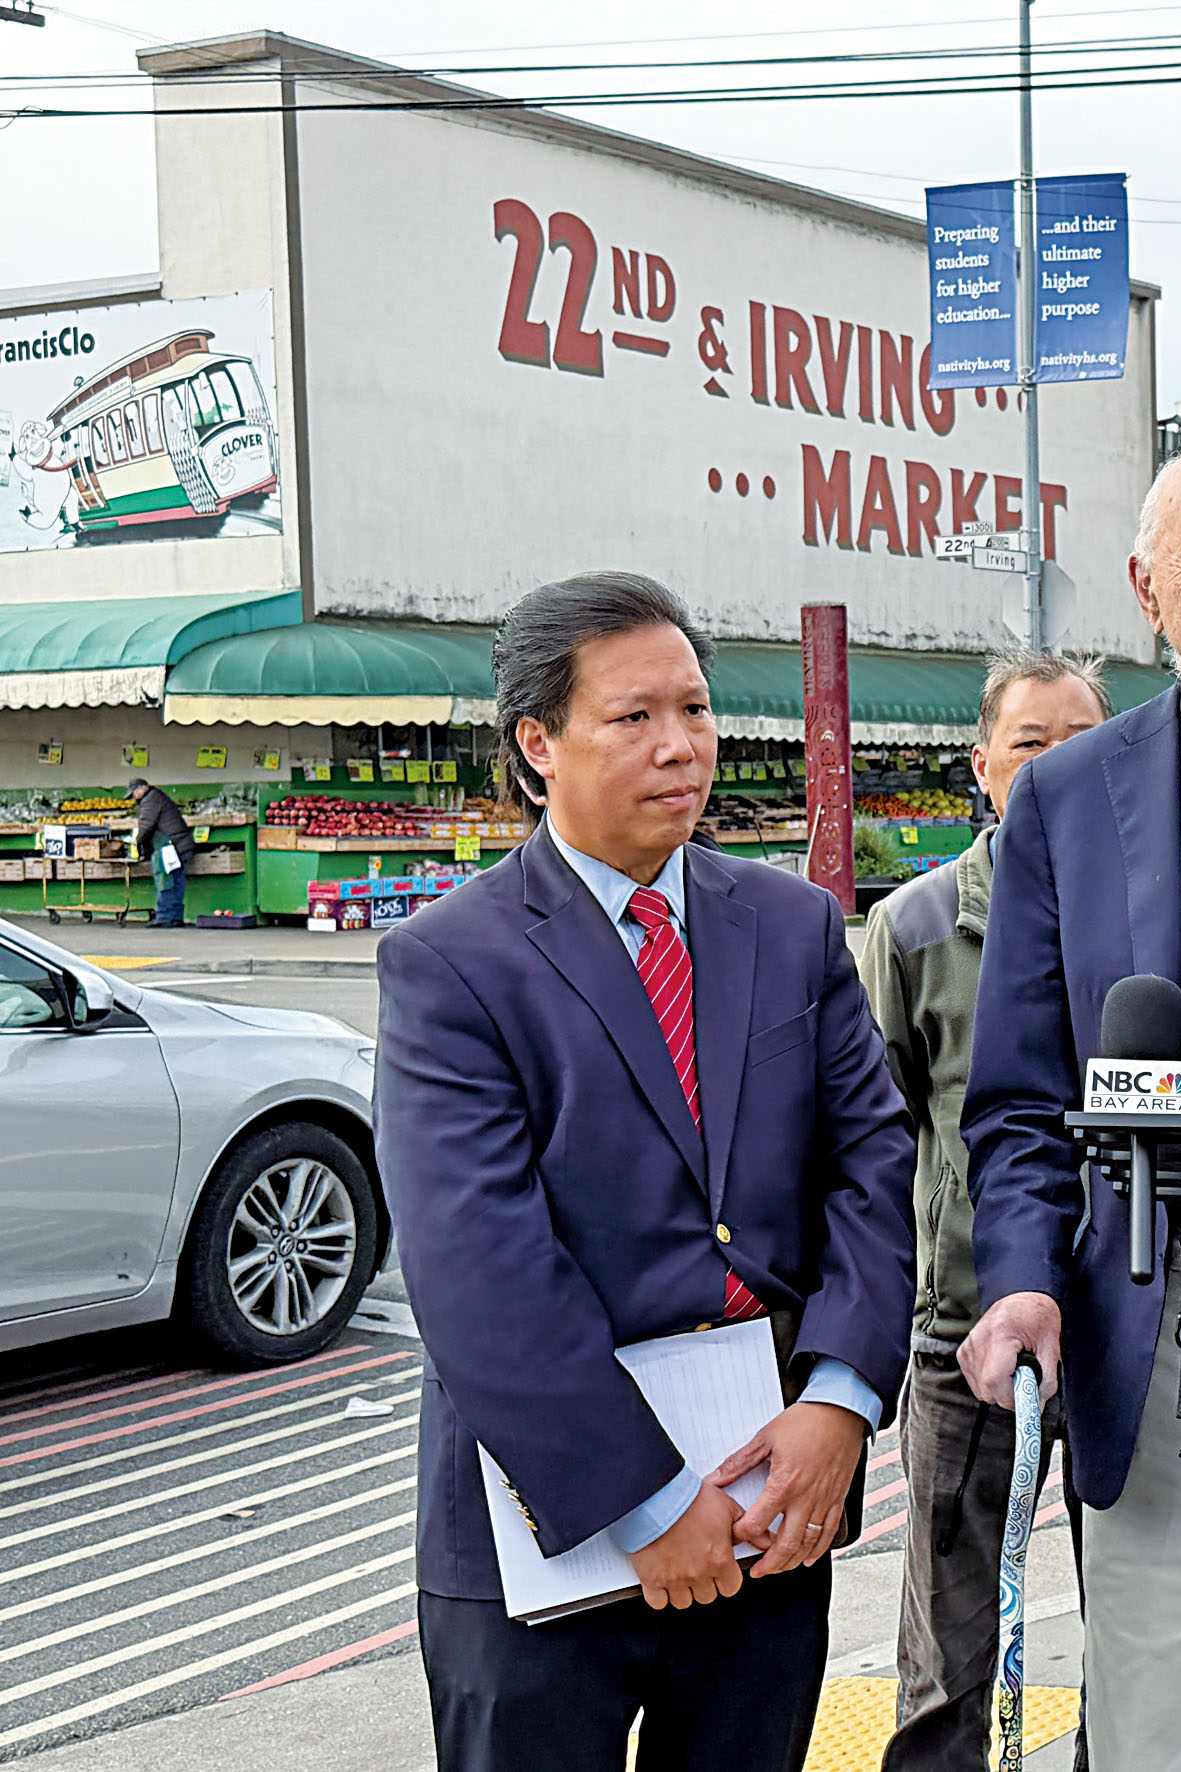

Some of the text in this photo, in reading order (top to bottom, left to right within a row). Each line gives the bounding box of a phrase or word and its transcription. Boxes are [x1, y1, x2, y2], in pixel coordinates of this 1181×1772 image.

[1082, 215, 1117, 233] their
[933, 225, 1000, 247] Preparing
[935, 251, 990, 271] students
[1042, 244, 1102, 262] ultimate
[936, 276, 1001, 299] for higher
[1042, 271, 1091, 293] higher
[936, 305, 1011, 324] education...
[1041, 302, 1101, 321] purpose
[699, 305, 733, 375] &
[937, 357, 1011, 373] nativityhs.org
[1040, 351, 1119, 367] nativityhs.org
[221, 433, 263, 457] CLOVER
[801, 443, 1067, 560] MARKET
[944, 539, 976, 553] 22nd
[986, 551, 1015, 570] Irving
[1092, 1071, 1153, 1095] NBC
[1090, 1096, 1128, 1109] BAY
